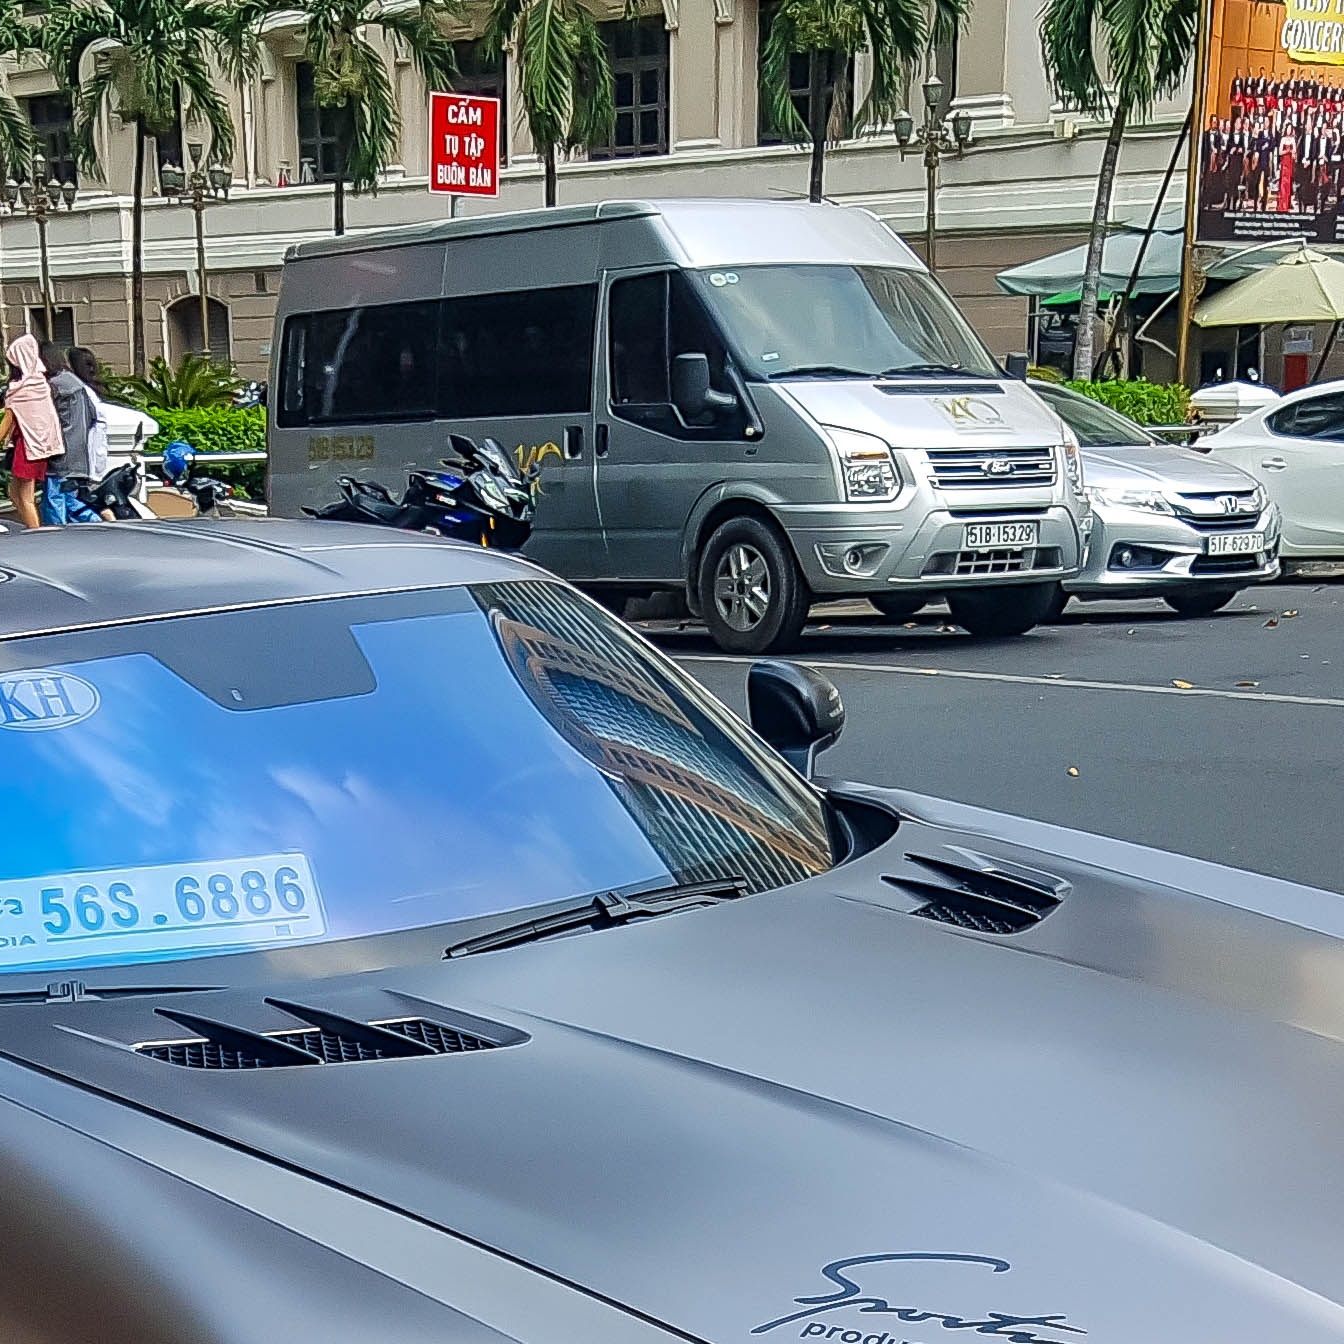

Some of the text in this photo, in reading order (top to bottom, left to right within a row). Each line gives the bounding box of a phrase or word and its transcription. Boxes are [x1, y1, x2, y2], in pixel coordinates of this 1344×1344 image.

[447, 98, 482, 126] CẤM
[444, 132, 486, 160] TỤ TẬP
[437, 162, 492, 187] BUÔN BÁN
[40, 866, 306, 935] 56S.6886
